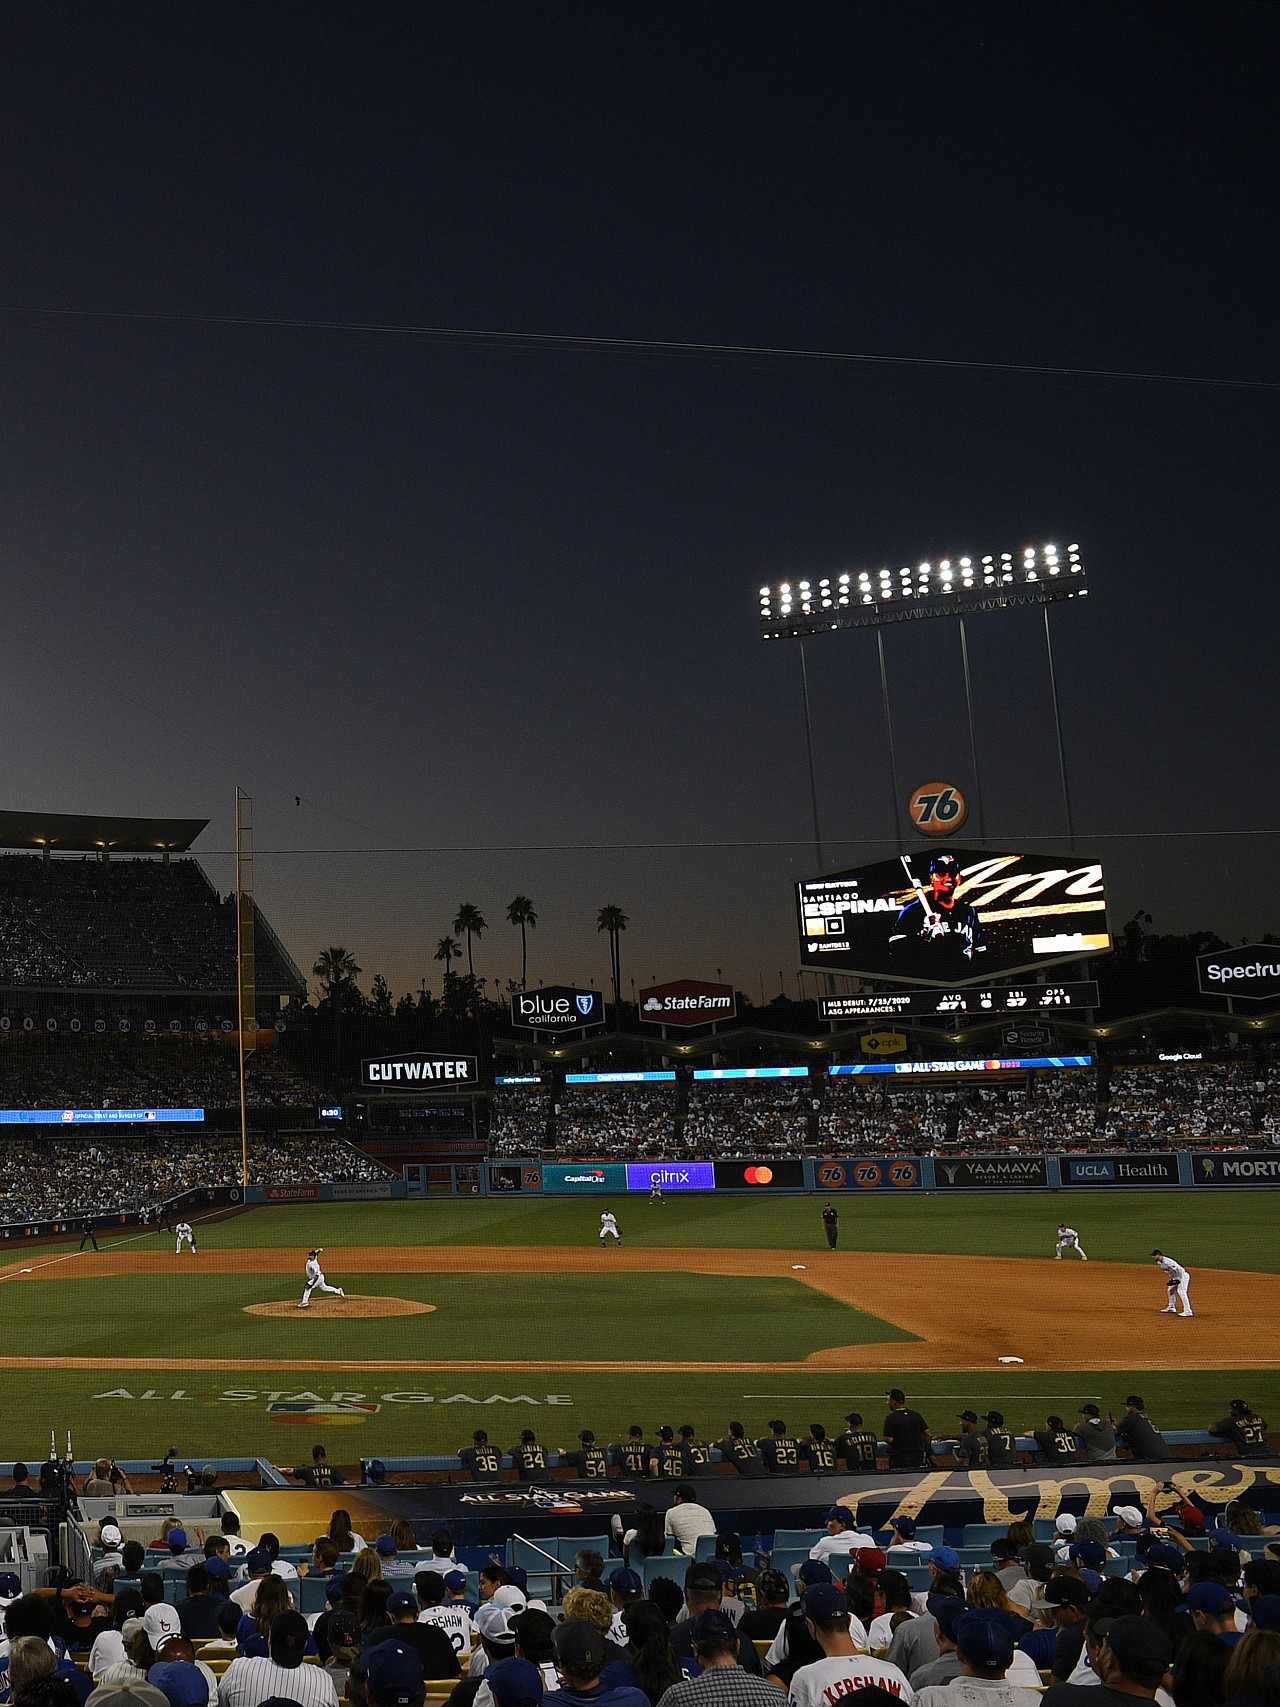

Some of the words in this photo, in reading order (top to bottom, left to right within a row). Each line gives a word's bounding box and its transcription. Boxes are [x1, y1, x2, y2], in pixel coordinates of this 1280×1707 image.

[913, 788, 962, 825] 76
[803, 893, 859, 903] SANTIAGO
[805, 898, 905, 917] ESPINAL
[520, 995, 570, 1014] blue
[843, 999, 867, 1007] DEBUT:
[844, 1007, 896, 1015] APPEARANCES:
[936, 1001, 967, 1011] .271
[1007, 997, 1027, 1007] 37
[1039, 995, 1071, 1006] .711
[528, 1013, 577, 1024] california
[881, 1036, 901, 1048] cpk
[1019, 1030, 1046, 1040] Security
[1158, 1053, 1182, 1062] Google
[1183, 1052, 1203, 1060] Cloud
[369, 1061, 468, 1081] CUTWATER
[913, 1062, 930, 1073] ALL
[932, 1061, 956, 1072] STAR
[956, 1060, 985, 1071] GAME
[525, 1172, 539, 1183] 76
[650, 1170, 690, 1185] citrix
[822, 1166, 842, 1182] 76
[857, 1165, 877, 1182] 76
[892, 1165, 912, 1182] 76
[1076, 1166, 1109, 1176] UCLA
[1118, 1163, 1169, 1177] Health
[1223, 1161, 1280, 1177] MORT
[91, 1388, 194, 1400] ALL
[217, 1389, 368, 1403] STAR
[380, 1391, 574, 1406] GAME
[1000, 1434, 1011, 1451] 7
[1243, 1425, 1264, 1444] 27
[733, 1444, 757, 1460] 30
[856, 1443, 874, 1461] 18
[1054, 1436, 1077, 1453] 30
[475, 1455, 499, 1472] 36
[522, 1453, 546, 1470] 24
[625, 1454, 644, 1471] 41
[690, 1447, 710, 1464] 37
[775, 1448, 798, 1465] 23
[816, 1450, 834, 1468] 16
[585, 1460, 608, 1478] 54
[663, 1458, 683, 1478] 46
[459, 1493, 502, 1502] ALL
[426, 1614, 463, 1629] ERSHAW
[823, 1675, 902, 1706] KERSHAW
